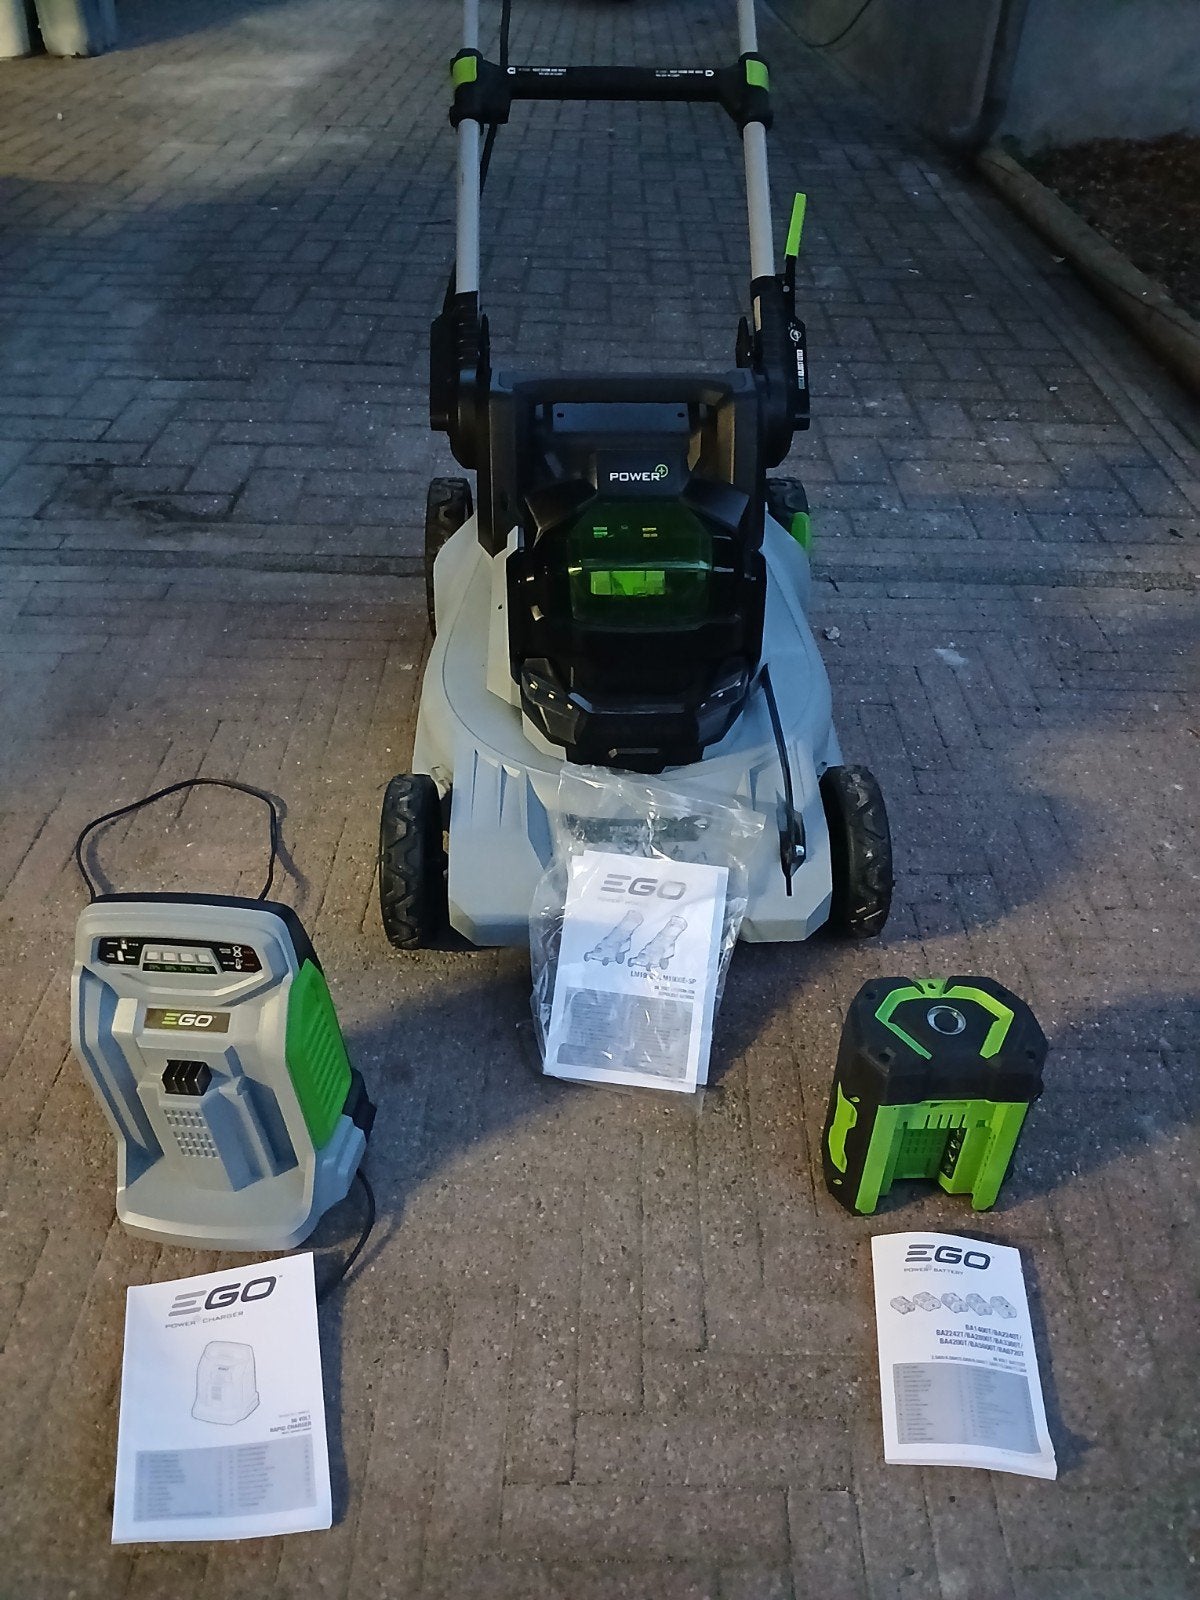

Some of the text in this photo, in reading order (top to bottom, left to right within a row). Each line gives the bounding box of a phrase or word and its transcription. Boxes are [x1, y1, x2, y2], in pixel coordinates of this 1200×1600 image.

[609, 472, 660, 481] POWER
[600, 873, 687, 900] EGO
[162, 1012, 213, 1027] EGO
[905, 1244, 991, 1270] EGO
[168, 1276, 277, 1317] EGO
[165, 1311, 244, 1329] POWER CHARGER
